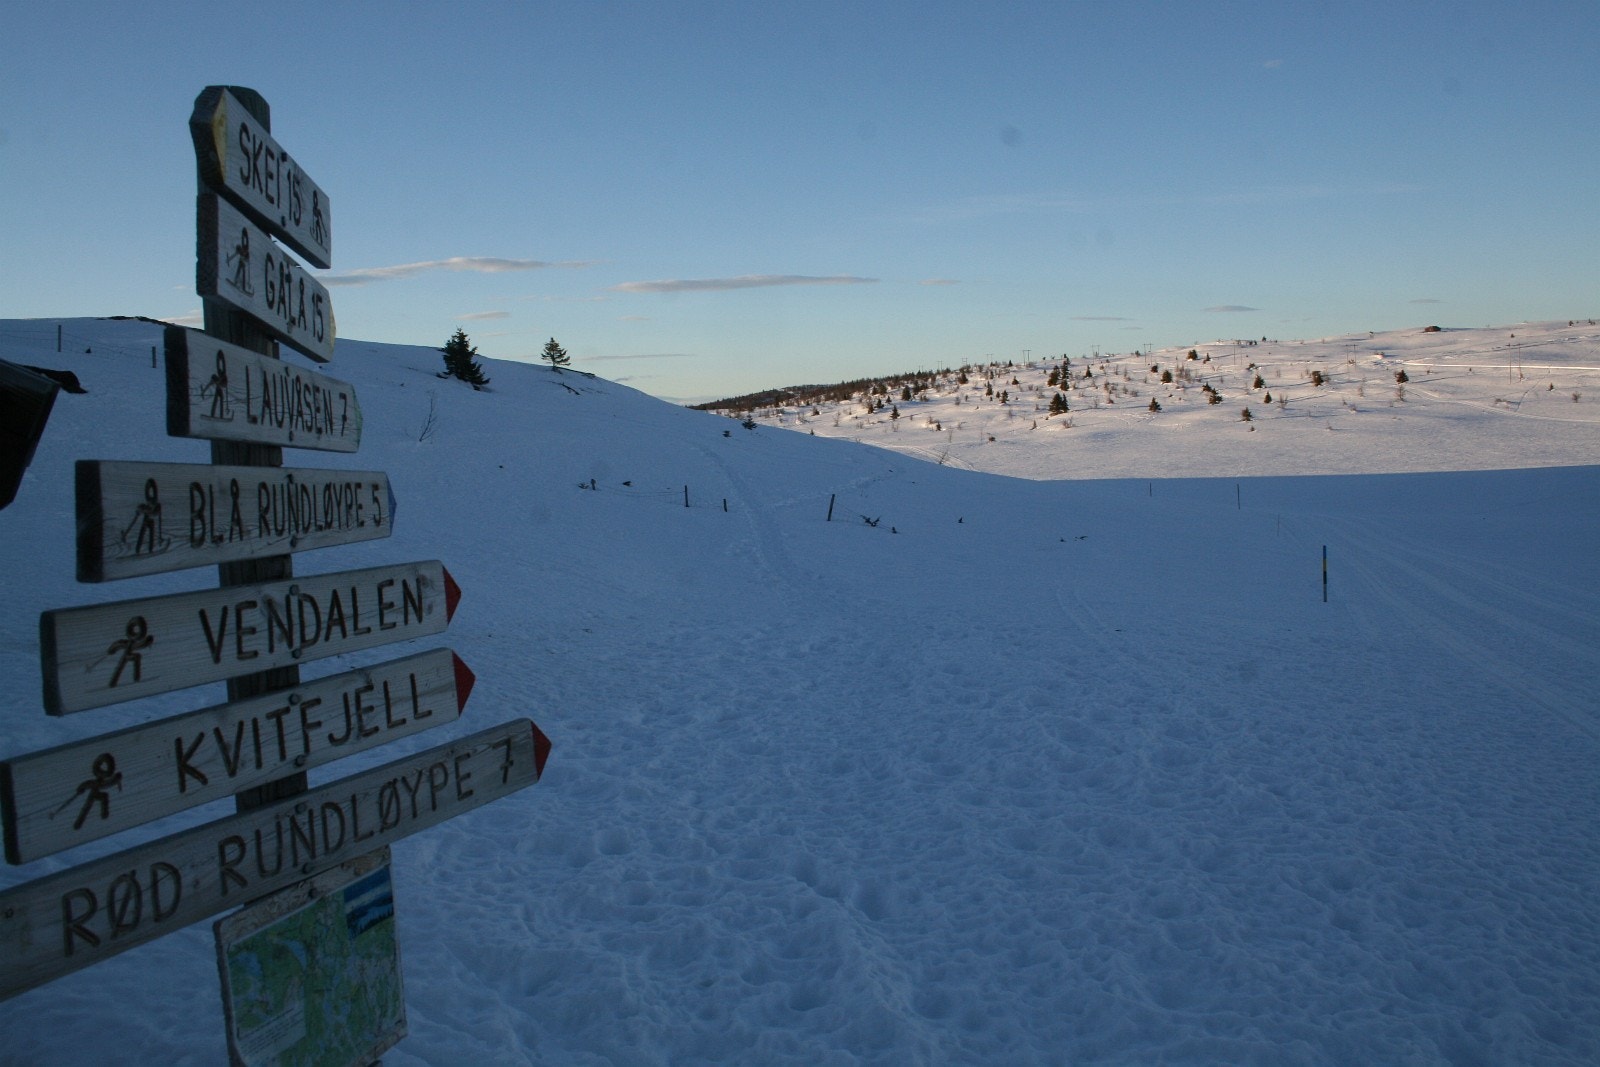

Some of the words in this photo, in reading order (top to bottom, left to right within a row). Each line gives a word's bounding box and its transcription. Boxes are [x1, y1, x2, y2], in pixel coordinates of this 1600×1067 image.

[239, 121, 281, 210] SKEI
[287, 168, 302, 227] 15
[311, 291, 325, 343] 15
[245, 365, 334, 436] LAUVÅSEN
[339, 392, 348, 437] 7
[189, 478, 243, 548] BLÅ
[258, 480, 365, 538] RUNDLØYPE
[372, 483, 382, 527] 5
[198, 577, 424, 664] VENDALEN
[174, 673, 433, 794] KVITFJELL
[60, 860, 182, 956] RØD
[217, 751, 475, 896] RUNDLØYPE
[492, 737, 515, 785] 7
